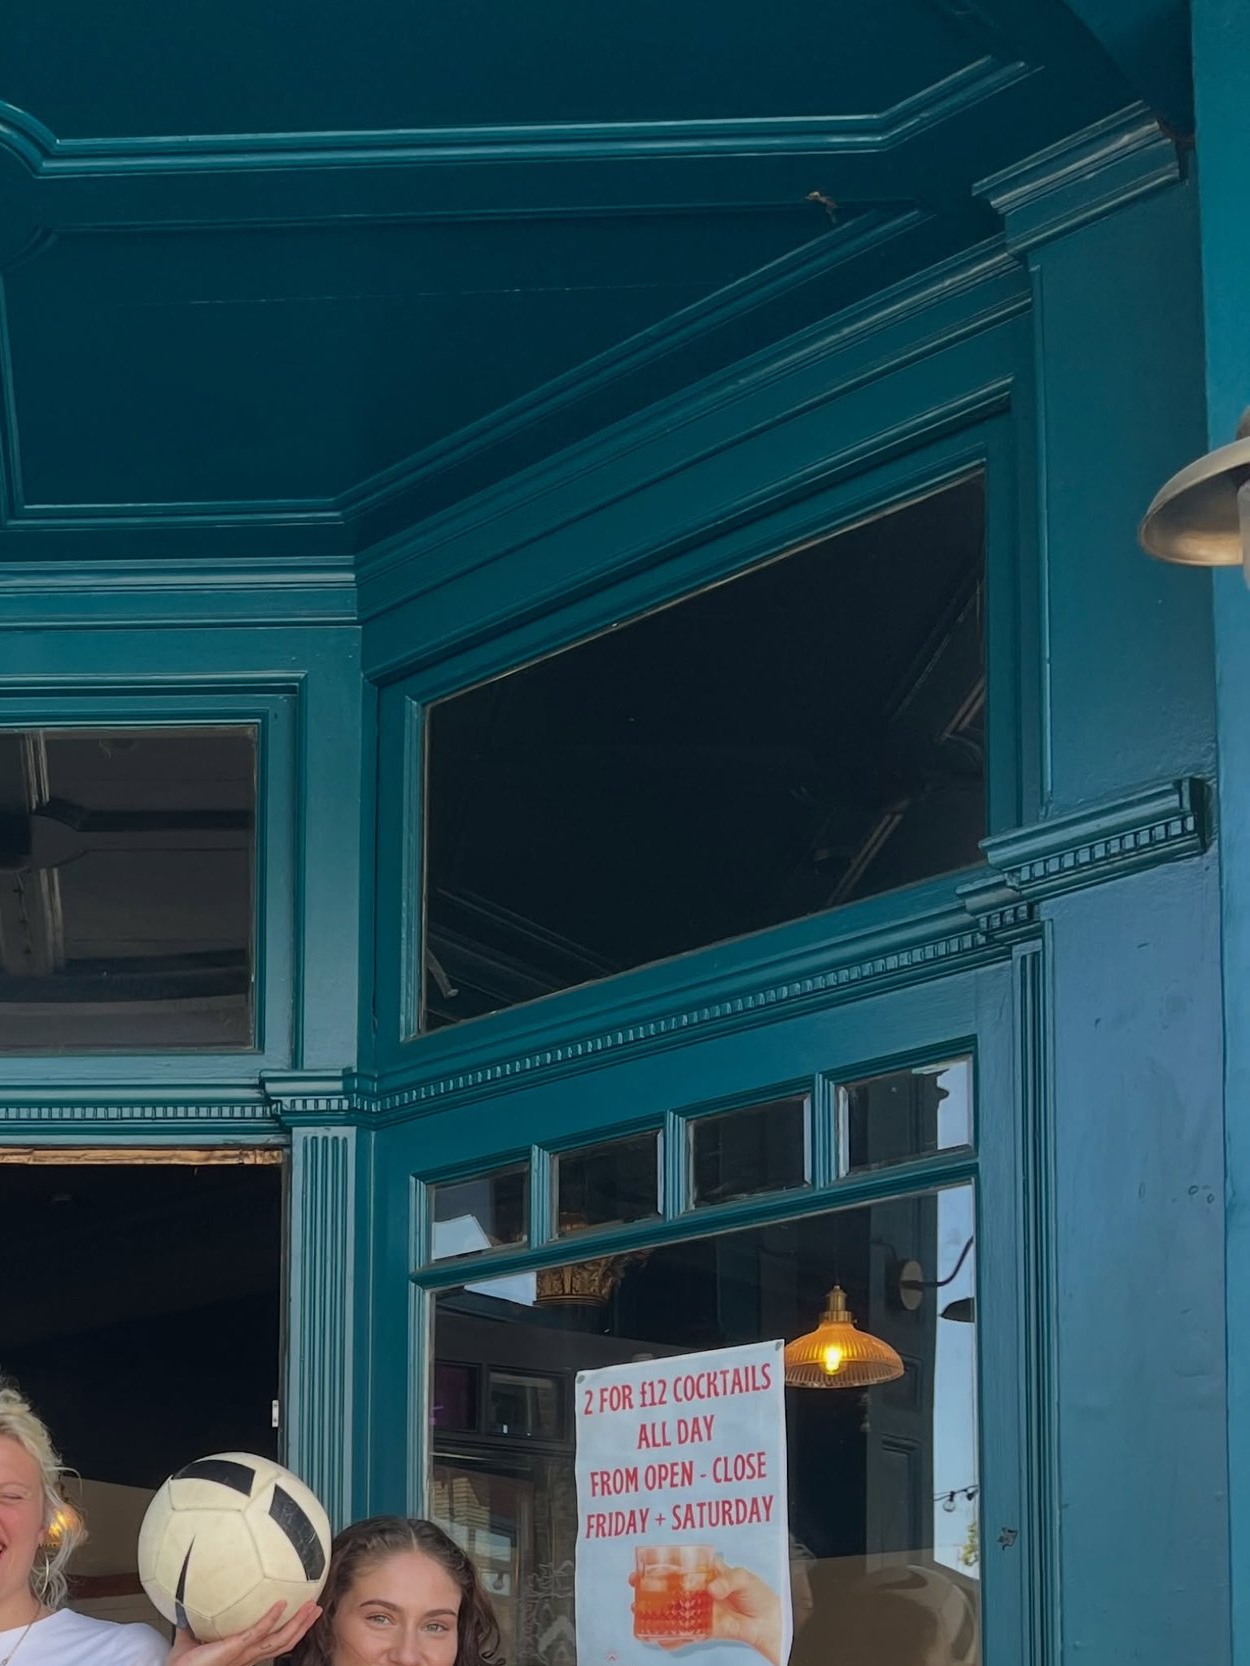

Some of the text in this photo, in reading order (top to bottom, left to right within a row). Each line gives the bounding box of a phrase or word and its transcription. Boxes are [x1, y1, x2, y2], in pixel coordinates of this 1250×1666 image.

[583, 1362, 772, 1415] 2 FOR £12 COCKTAILS
[637, 1415, 715, 1450] ALL DAY
[590, 1466, 639, 1497] FROM
[644, 1460, 694, 1491] OPEN
[712, 1451, 767, 1483] CLOSE
[585, 1495, 774, 1539] FRIDAY + SATURDAY
